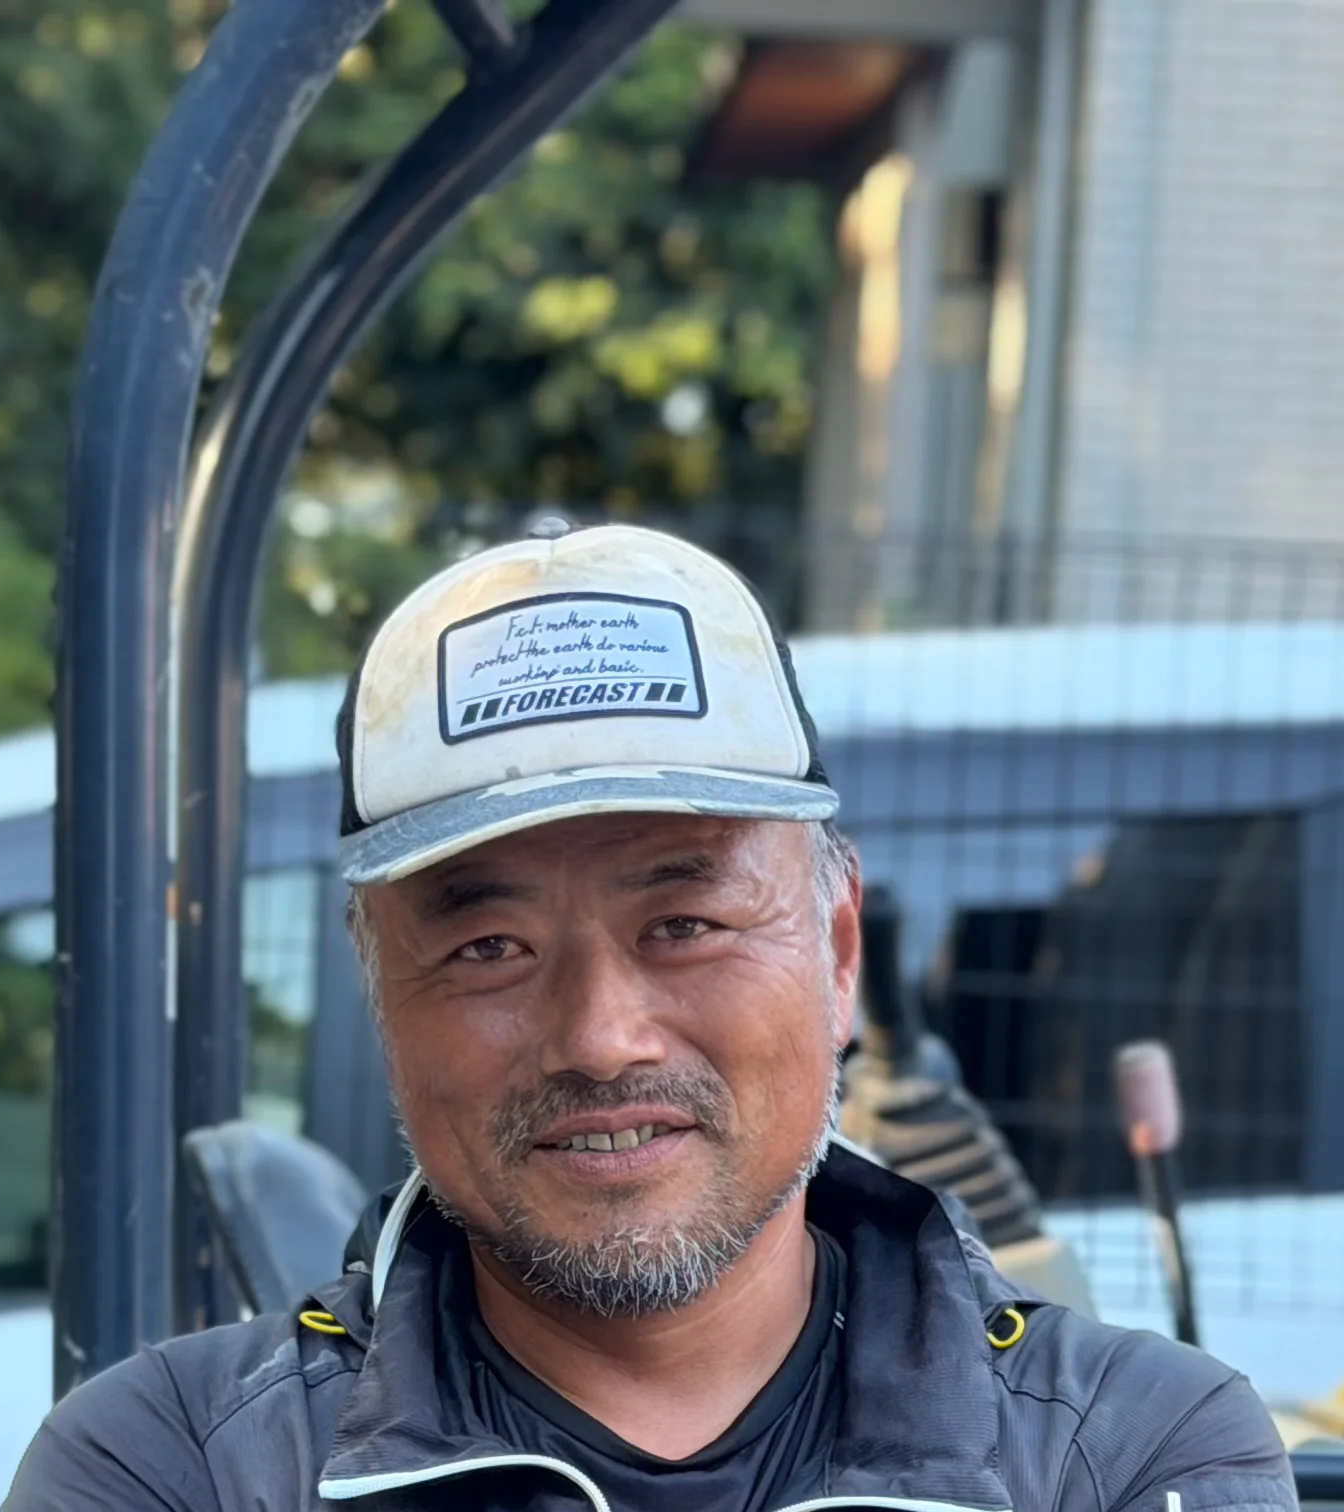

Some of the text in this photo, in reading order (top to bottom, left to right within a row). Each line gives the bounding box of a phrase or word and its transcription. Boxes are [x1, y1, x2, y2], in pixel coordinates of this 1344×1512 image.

[546, 610, 596, 632] mother
[600, 611, 640, 629] earth
[553, 632, 594, 654] earth
[562, 658, 595, 676] and
[501, 682, 645, 717] FORECAST
